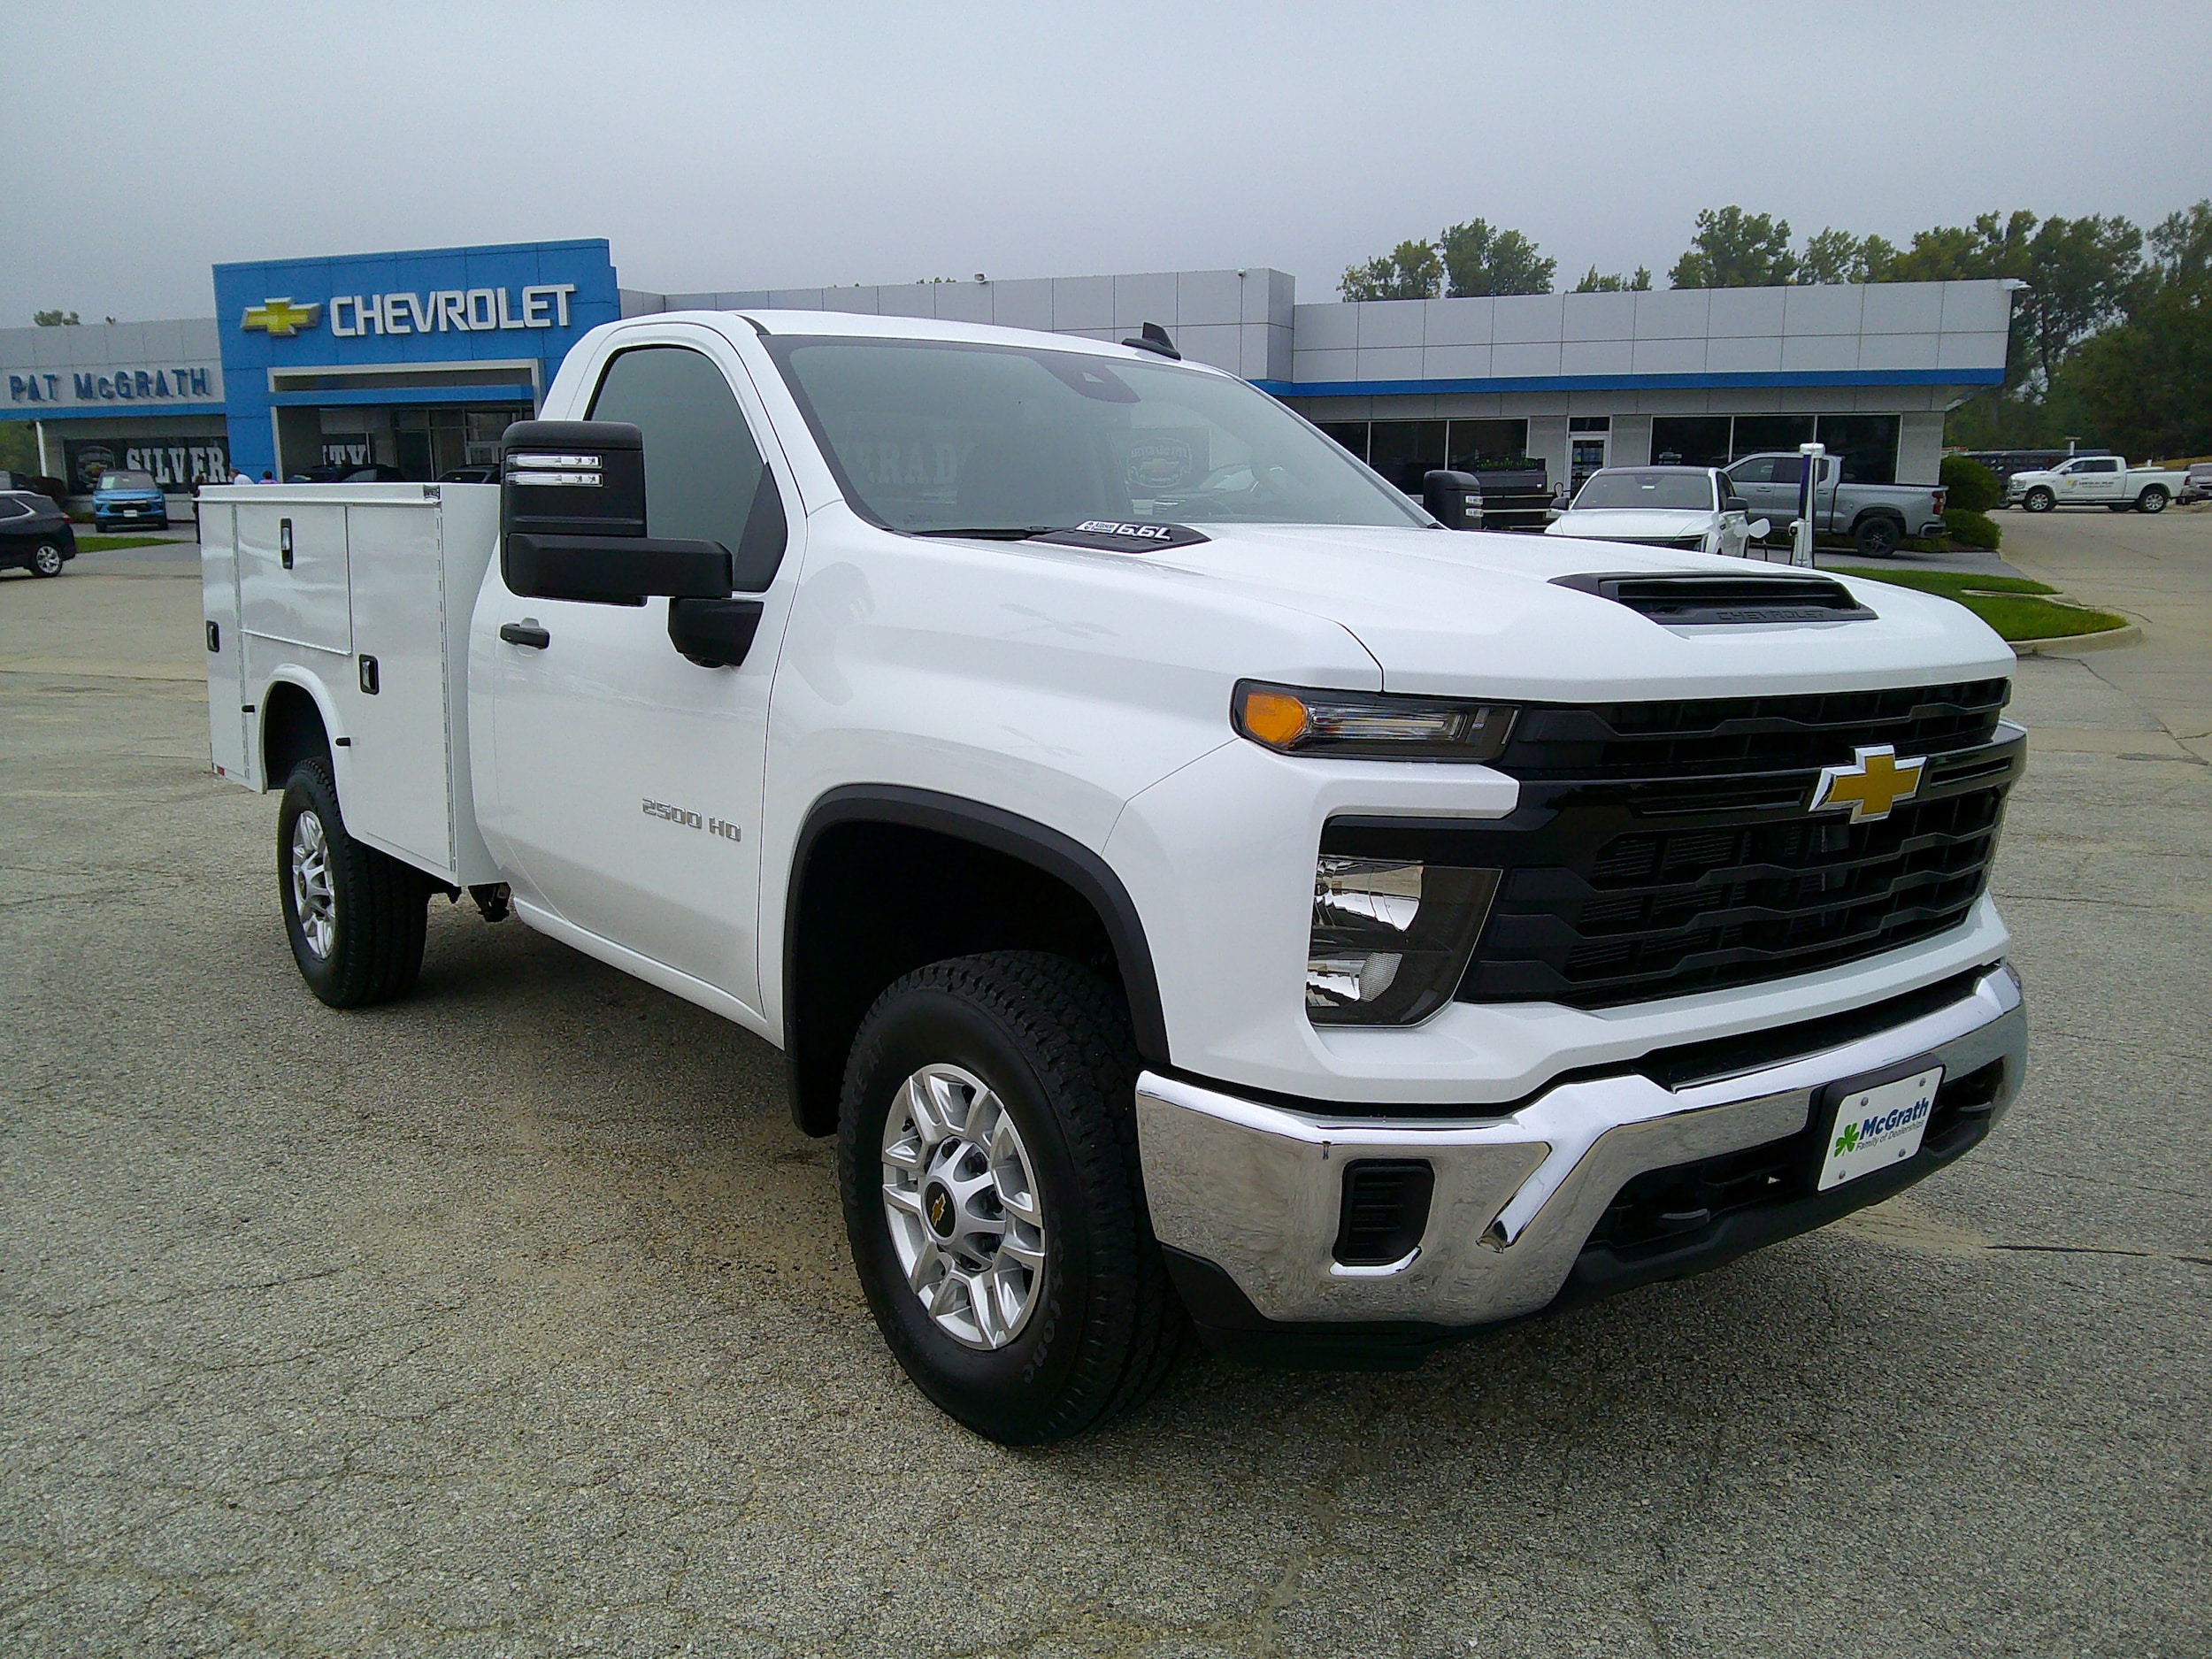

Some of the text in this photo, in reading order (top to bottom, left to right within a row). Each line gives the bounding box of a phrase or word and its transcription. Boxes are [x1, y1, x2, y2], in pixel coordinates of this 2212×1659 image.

[330, 283, 578, 336] CHEVROLET
[9, 368, 210, 401] PAT McGRATH
[126, 447, 226, 483] SILVER
[1716, 610, 1824, 620] CHEVROLET
[642, 796, 741, 842] 2500 HD
[1859, 1097, 1929, 1141] McGrath
[1855, 1136, 1879, 1151] Family
[1880, 1132, 1888, 1143] of
